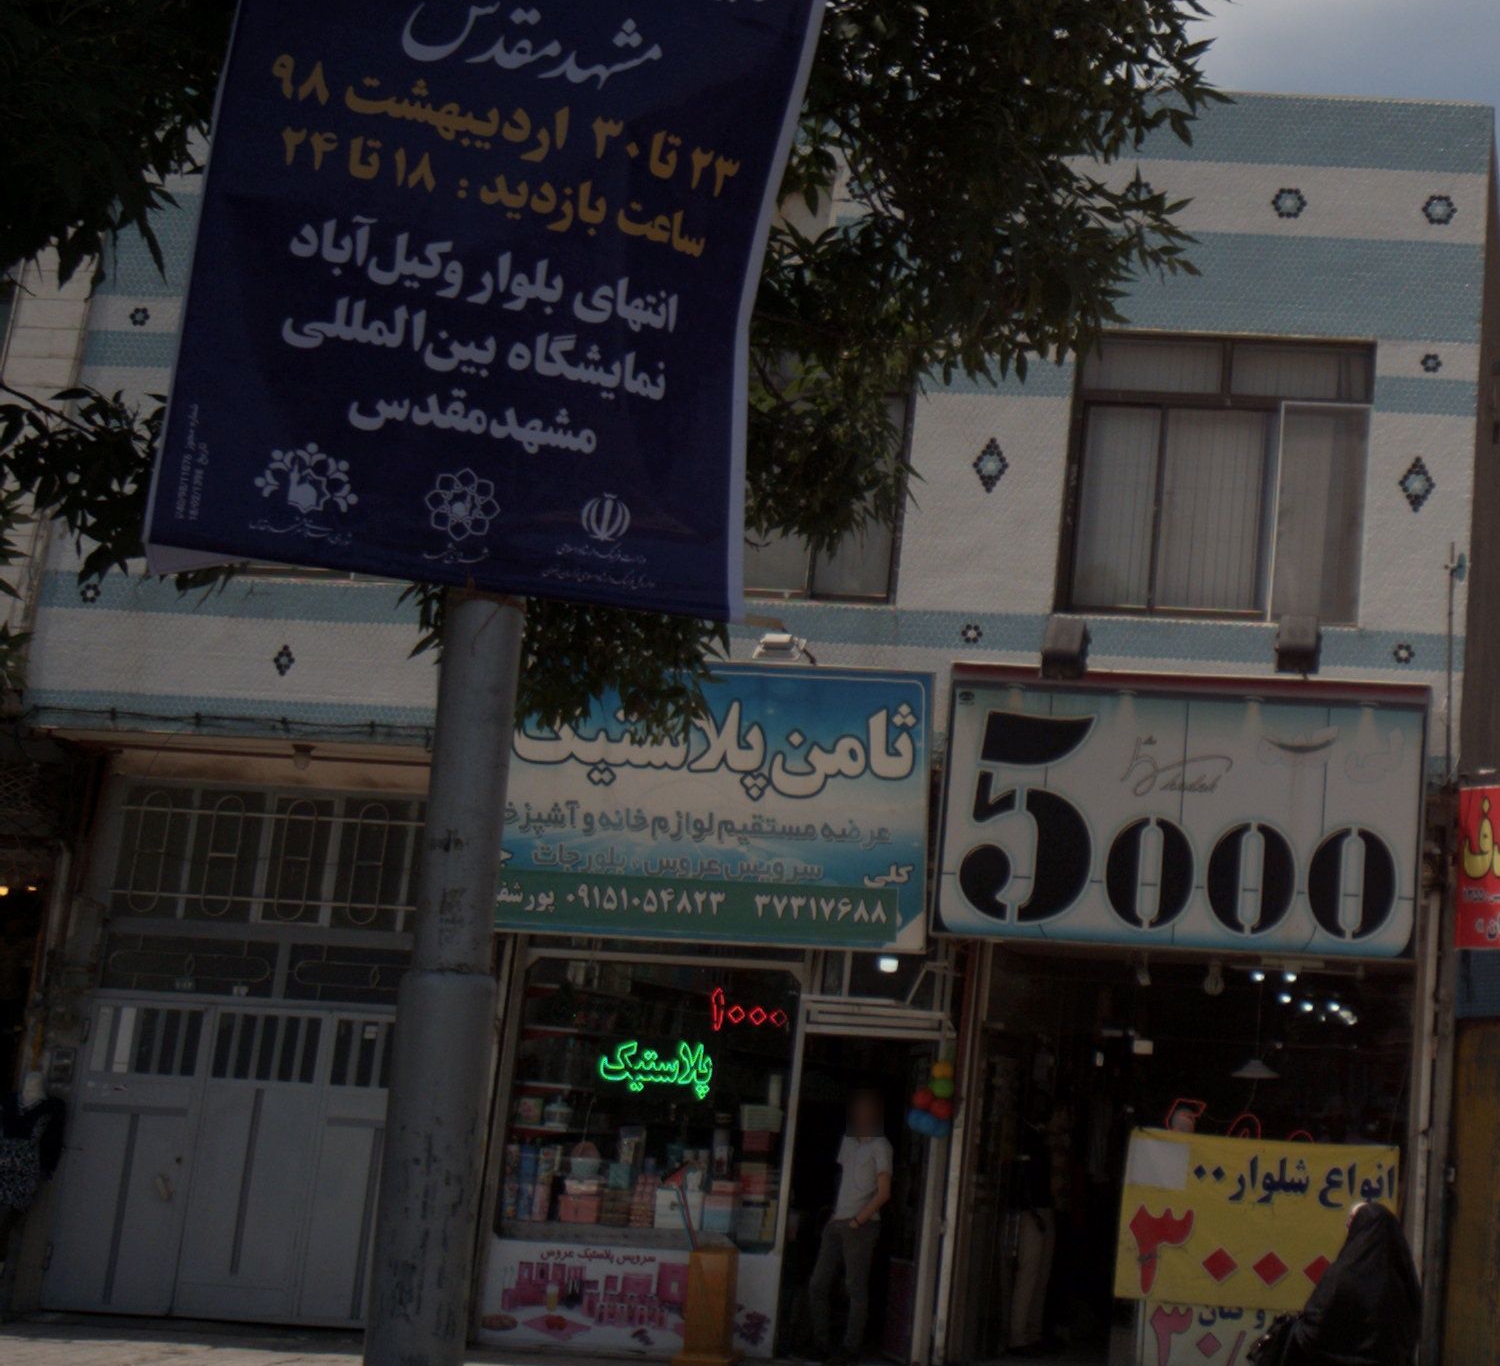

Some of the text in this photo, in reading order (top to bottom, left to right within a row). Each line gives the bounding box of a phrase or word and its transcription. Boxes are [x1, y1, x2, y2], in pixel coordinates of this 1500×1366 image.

[270, 53, 331, 106] ۹۸
[344, 77, 571, 163] اردیبهشت
[280, 124, 339, 171] ۲۴
[348, 133, 383, 180] تا
[394, 147, 436, 192] ۱۸
[690, 145, 742, 198] ۲۳
[616, 199, 707, 258] ساعت
[466, 251, 565, 315] بلوار
[572, 276, 680, 334] انتهای
[506, 331, 668, 402] نمایشگاه
[768, 701, 919, 798] ثامن
[582, 812, 596, 836] و
[598, 807, 649, 833] خانه
[650, 811, 714, 843] لوازم
[718, 812, 819, 845] مستقیم
[959, 710, 1398, 941] 5000
[724, 858, 825, 884] سرویس
[863, 861, 916, 888] کلی
[566, 883, 726, 914] ۰۹۱۵۱۰۵۴۸۲۳
[754, 893, 888, 924] ۳۷۳۱۷۶۸۸
[598, 1040, 715, 1101] پلاستیک
[1229, 1156, 1310, 1203] شلوار
[1318, 1163, 1396, 1208] انواع
